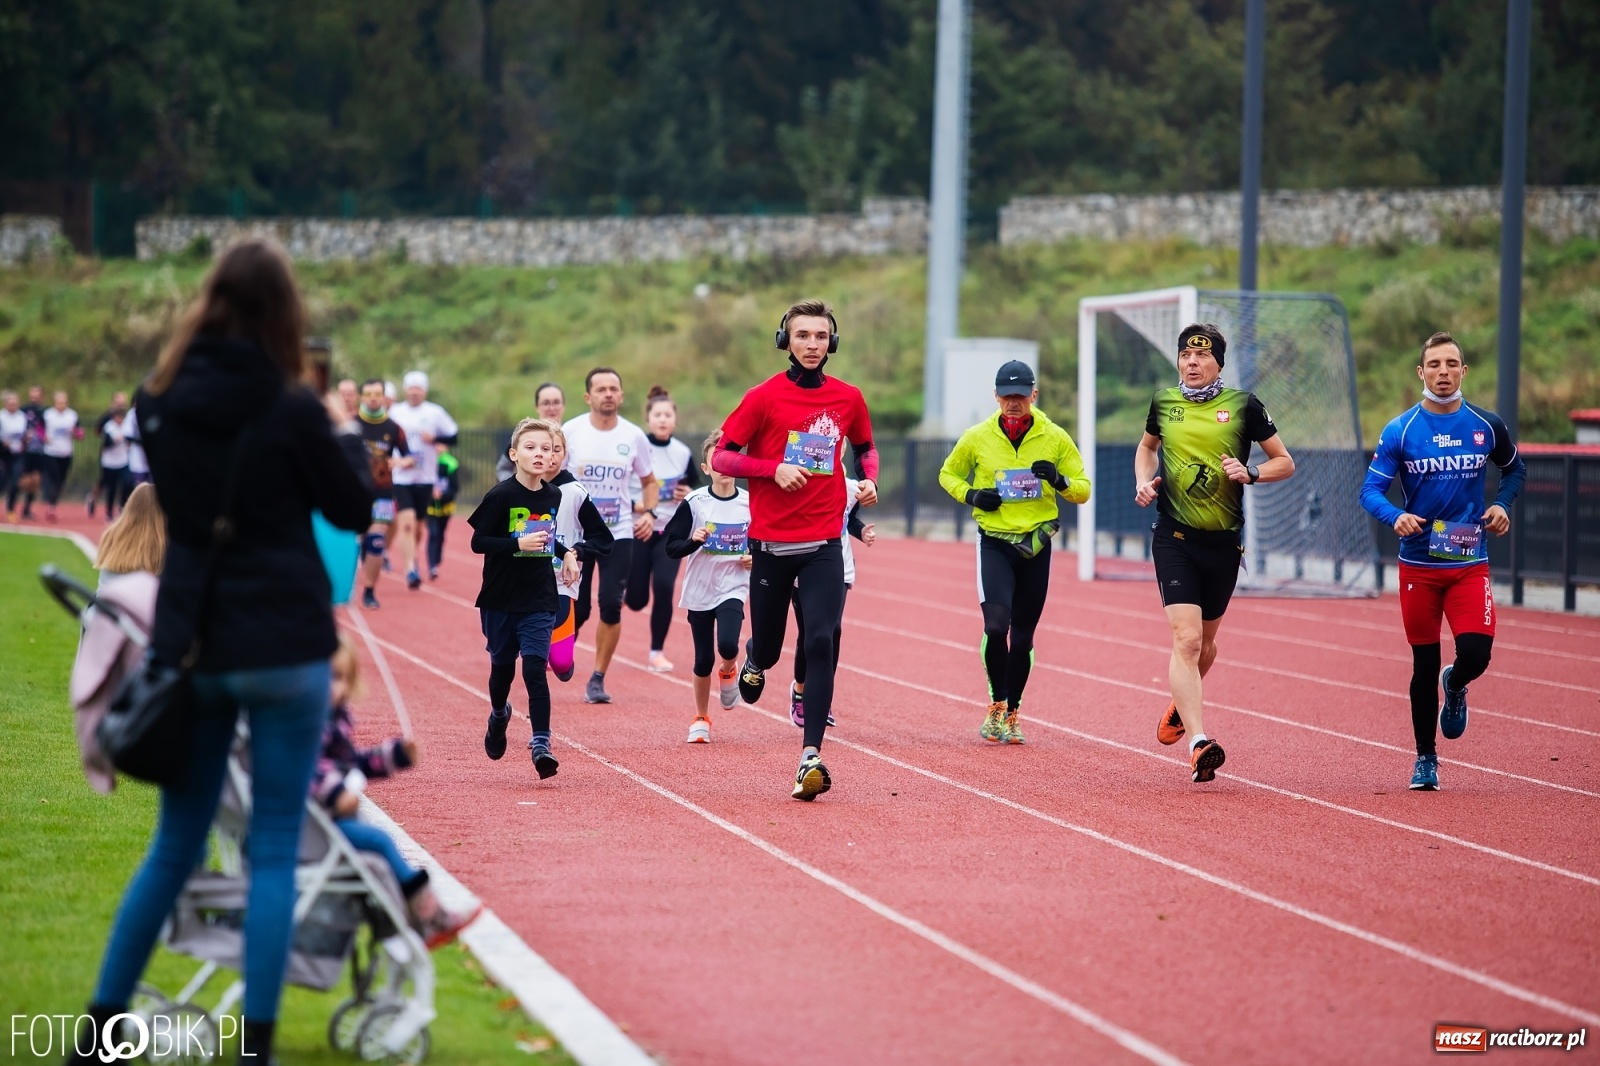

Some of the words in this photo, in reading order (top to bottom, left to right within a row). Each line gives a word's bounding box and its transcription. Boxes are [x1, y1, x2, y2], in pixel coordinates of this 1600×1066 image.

[1432, 433, 1451, 443] eko
[1438, 440, 1462, 448] okna
[812, 461, 830, 469] 350
[1461, 471, 1478, 479] TEAM
[1461, 547, 1476, 556] 110
[1483, 576, 1491, 626] POLSKA
